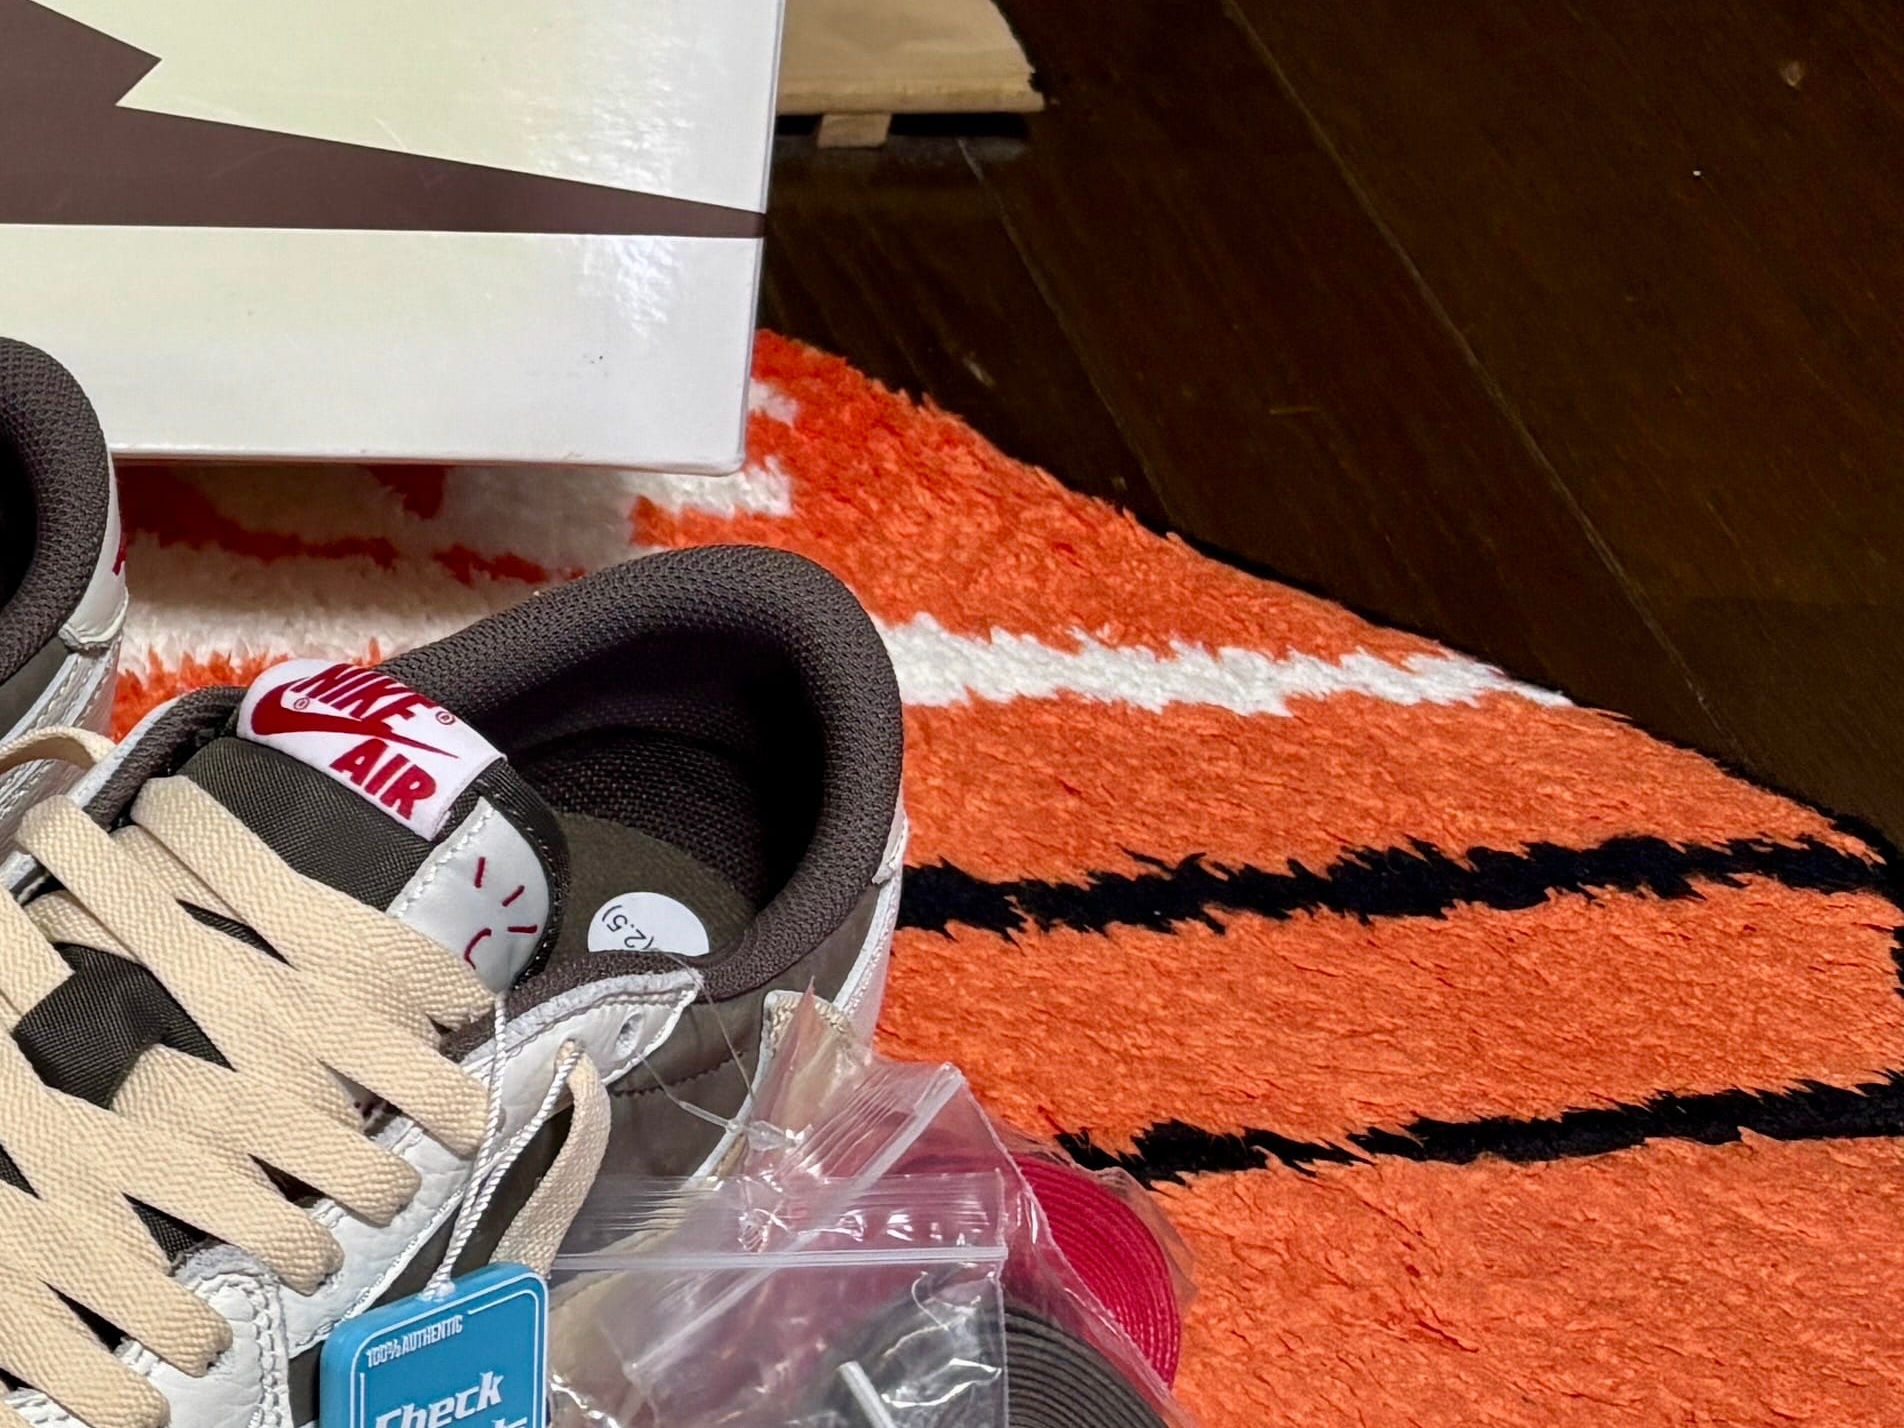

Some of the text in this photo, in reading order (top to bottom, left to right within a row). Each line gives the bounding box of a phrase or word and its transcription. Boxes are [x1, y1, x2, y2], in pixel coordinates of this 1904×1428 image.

[289, 663, 437, 730] NIKE
[329, 738, 437, 820] AIR
[401, 1314, 464, 1354] AUTHENTIC
